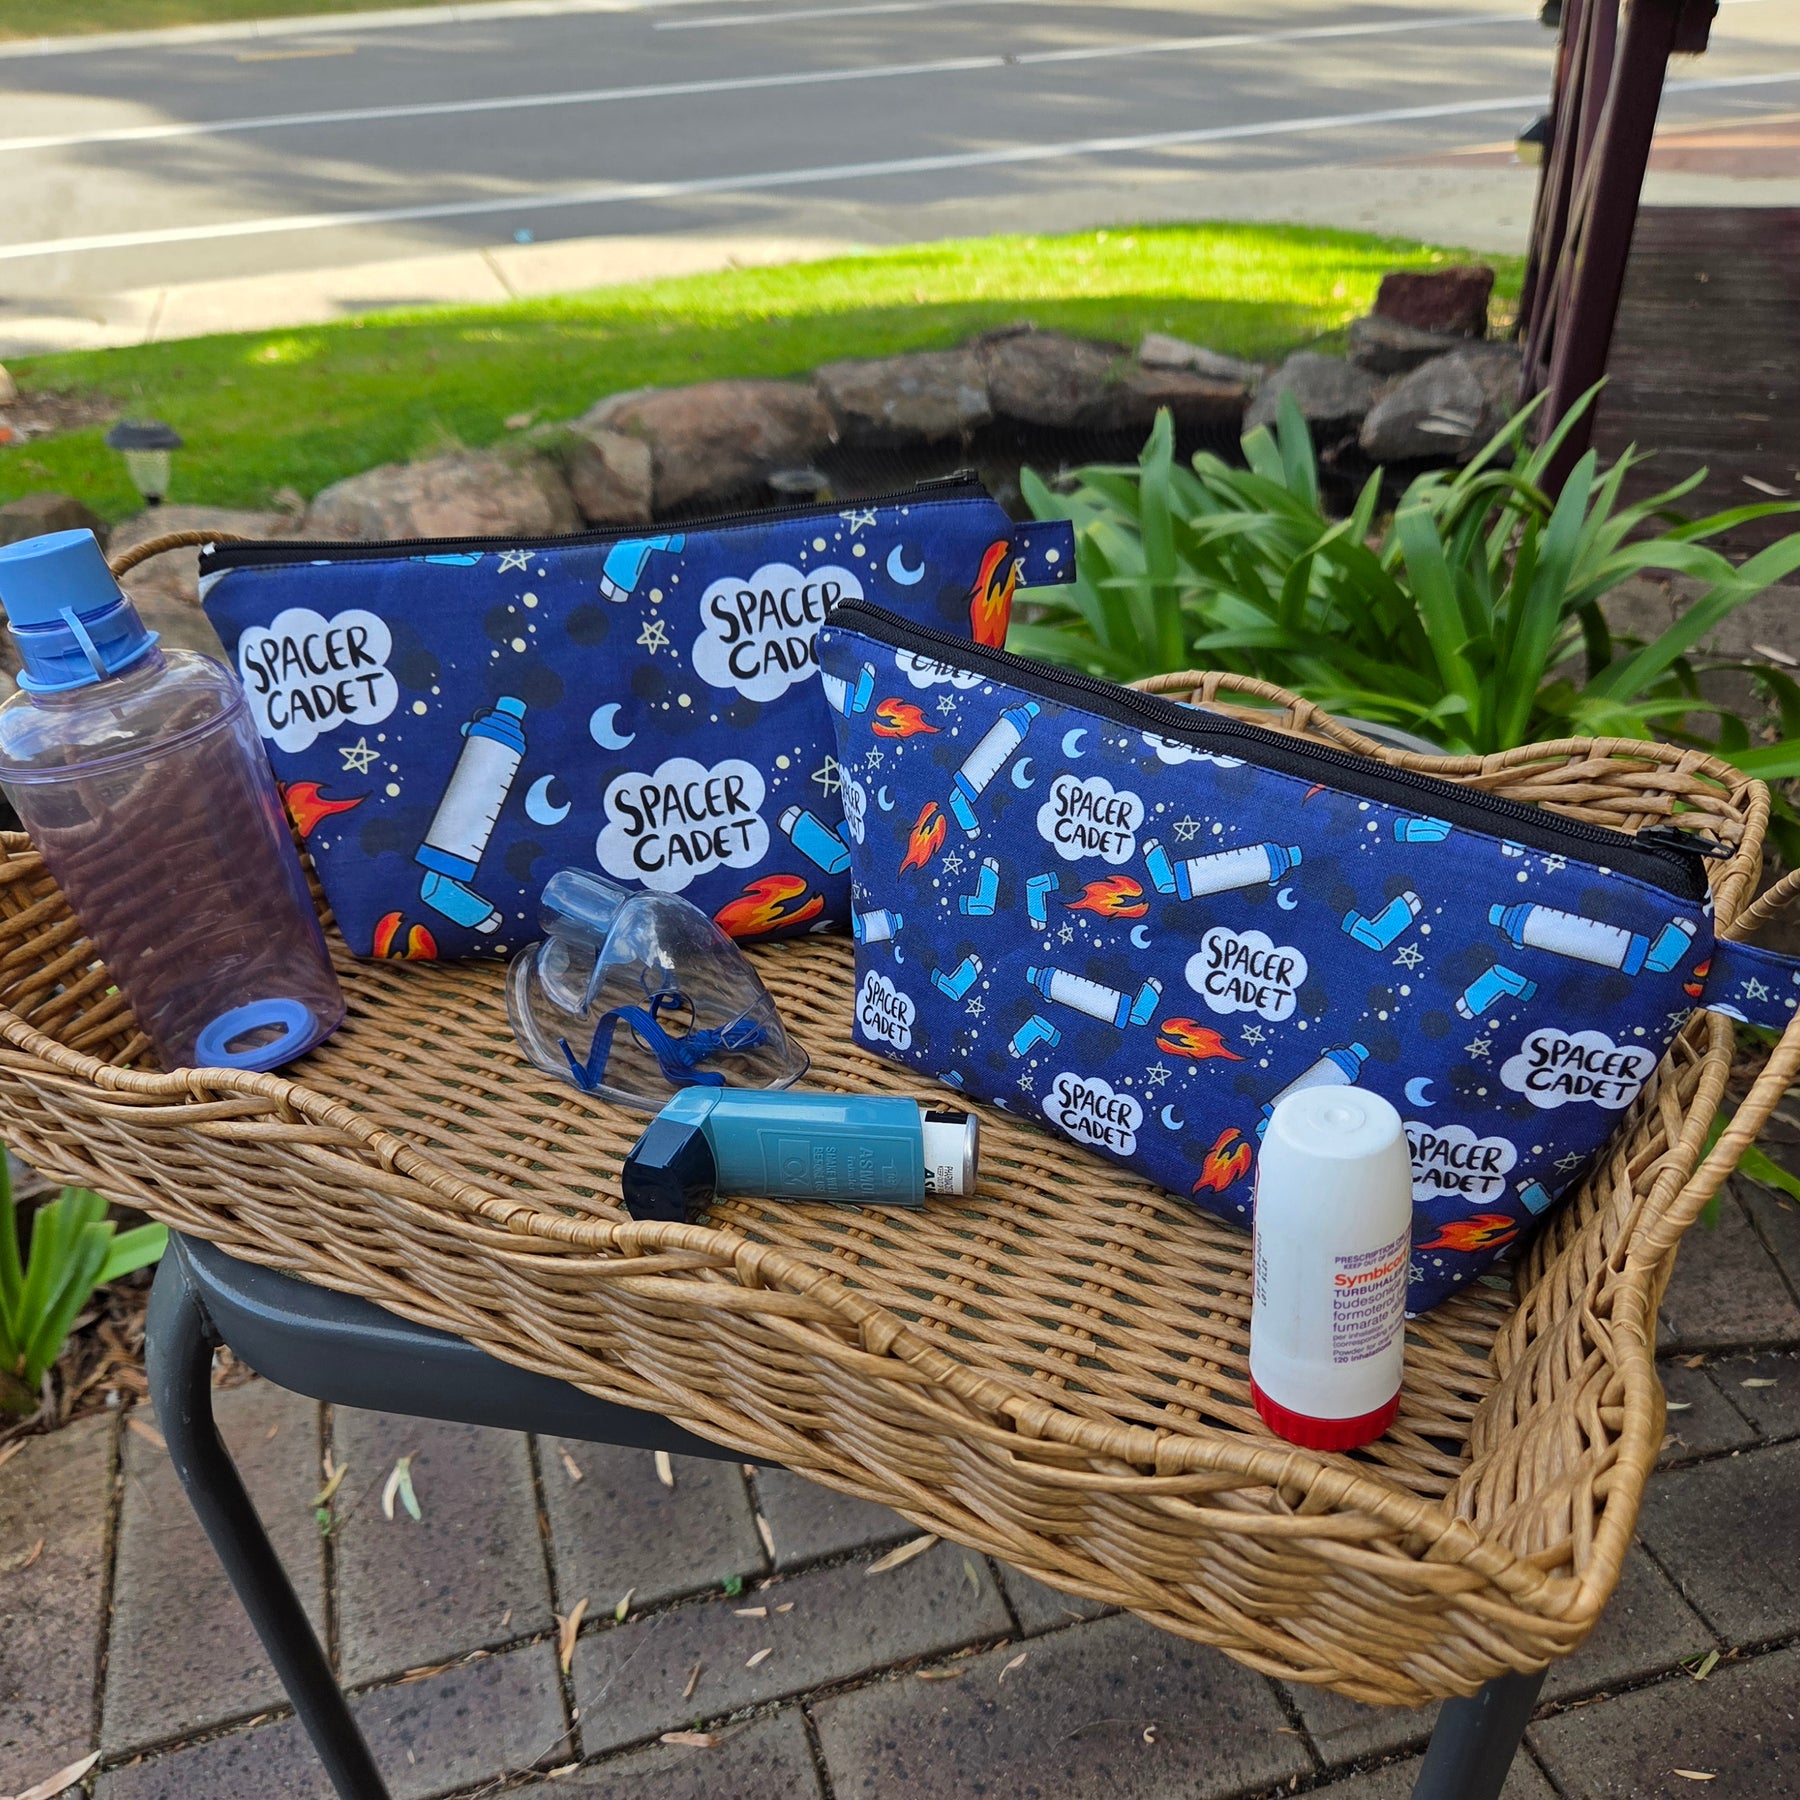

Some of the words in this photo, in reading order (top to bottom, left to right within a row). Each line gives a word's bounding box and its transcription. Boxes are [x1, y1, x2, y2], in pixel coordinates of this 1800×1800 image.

[245, 625, 377, 693] SPACER
[728, 632, 820, 680] CAD
[267, 672, 384, 731] CADET
[615, 774, 746, 836] SPACER
[1055, 783, 1133, 832] SPACER
[632, 818, 757, 872] CADET
[1054, 818, 1131, 856] CADET
[1206, 935, 1296, 987] SPACER
[864, 975, 909, 1022] SPACER
[1203, 970, 1292, 1013] CADET
[862, 1006, 909, 1043] CADET
[1529, 1039, 1642, 1080] SPACER
[1058, 1079, 1133, 1127] SPACER
[1526, 1068, 1640, 1103] CADET
[1060, 1111, 1132, 1149] CADET
[1334, 1242, 1395, 1264] PRESCRIPTION
[1344, 1262, 1362, 1270] KEEP
[1364, 1258, 1377, 1267] OUT
[1333, 1293, 1396, 1321] formoterol
[1333, 1311, 1389, 1333] fumarate
[1332, 1334, 1347, 1343] per
[1332, 1347, 1365, 1357] Powder
[1366, 1342, 1377, 1351] for
[1333, 1356, 1349, 1364] 120
